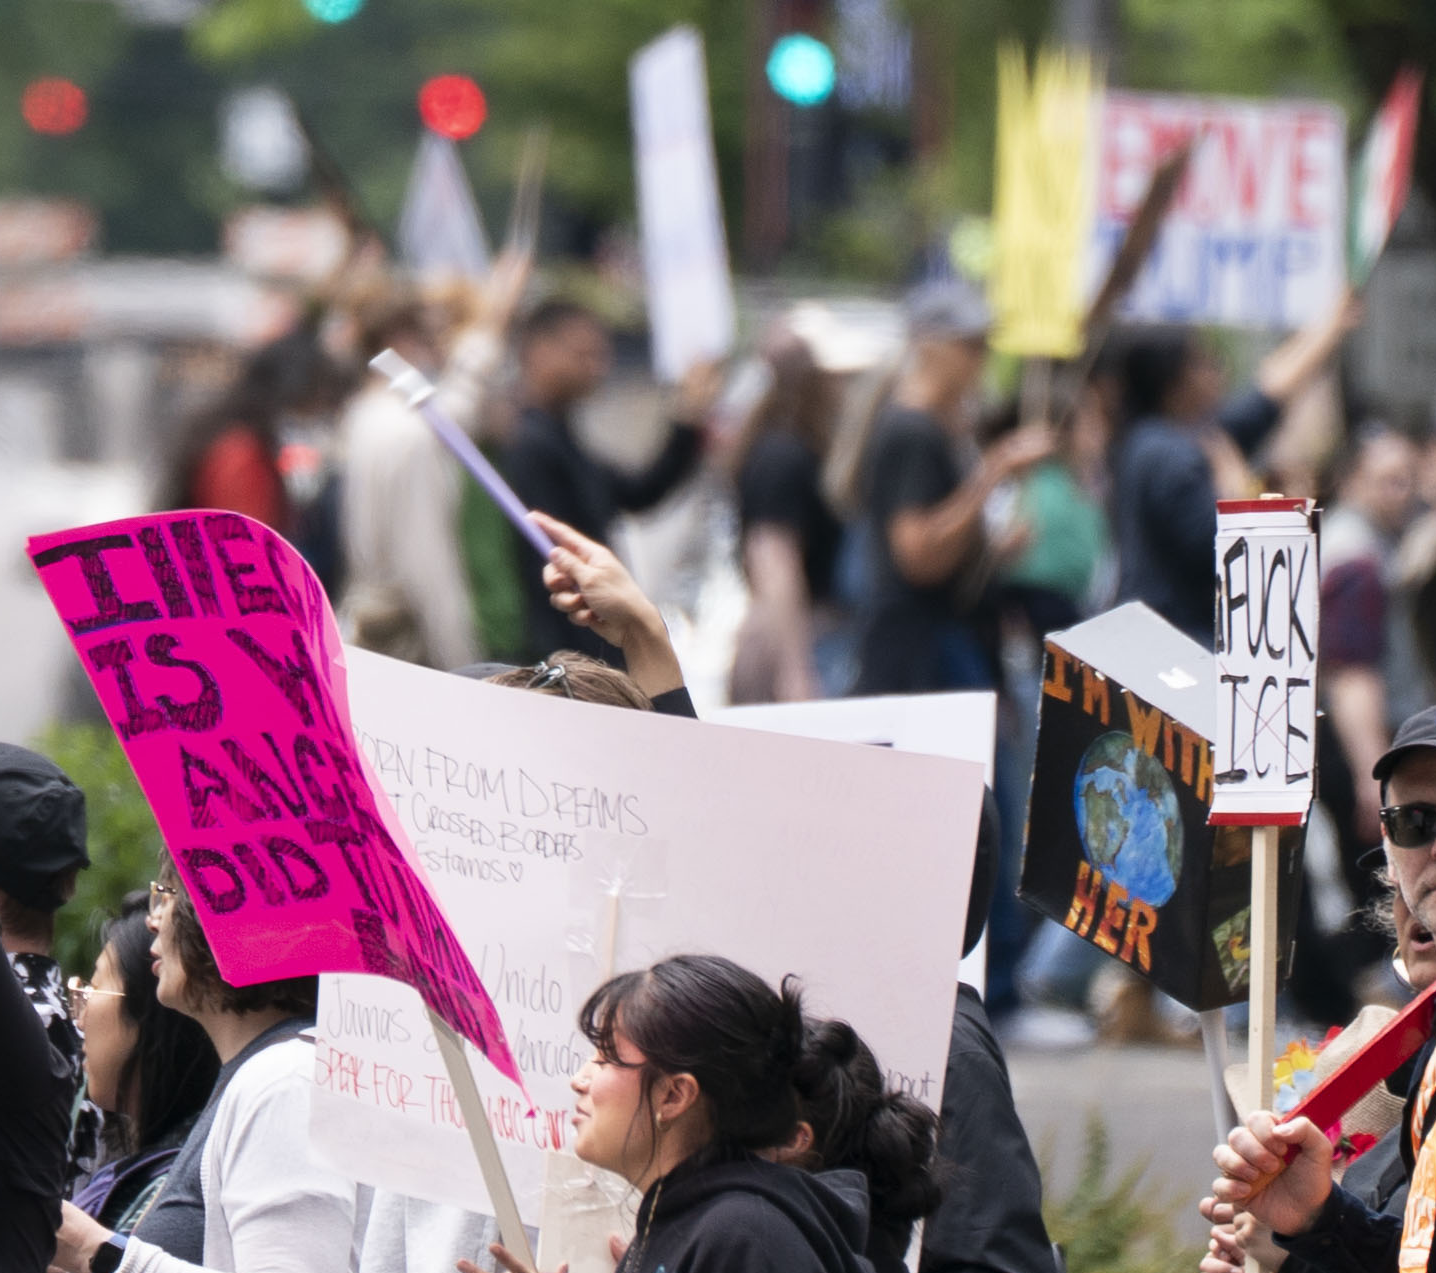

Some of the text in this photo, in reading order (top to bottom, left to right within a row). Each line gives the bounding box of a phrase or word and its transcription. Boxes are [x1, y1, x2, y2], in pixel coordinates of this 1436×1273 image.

[1222, 536, 1315, 668] FUCK
[88, 633, 224, 741] IS
[1041, 639, 1216, 806] I'M WITH
[1215, 674, 1310, 785] ICE
[411, 791, 496, 847] CROSSED
[424, 746, 510, 813] FROM
[518, 767, 649, 837] DREAMS
[180, 836, 331, 915] DID
[1064, 861, 1160, 973] HER
[326, 977, 412, 1044] Jamas
[314, 1038, 369, 1098] SPEAK
[372, 1063, 426, 1112] FOR
